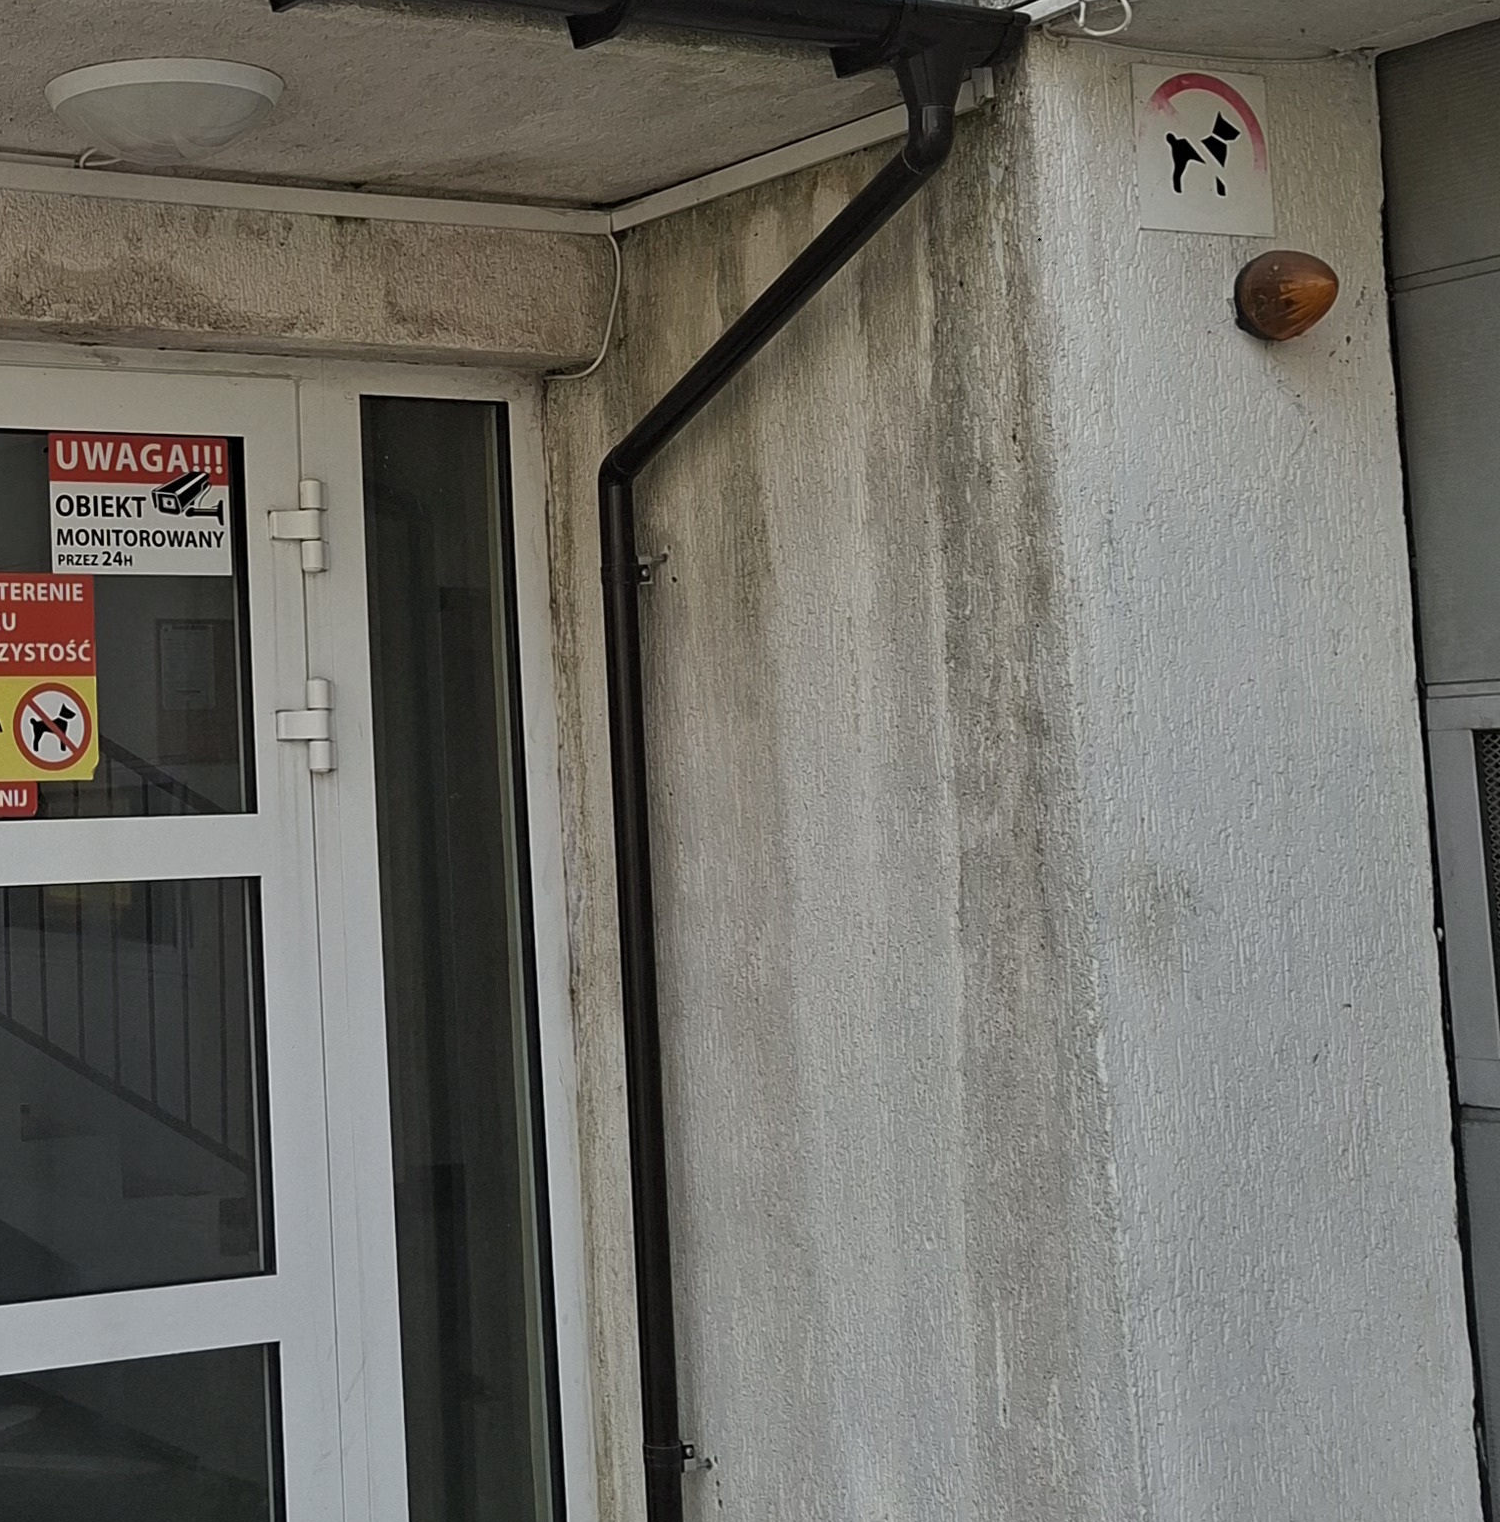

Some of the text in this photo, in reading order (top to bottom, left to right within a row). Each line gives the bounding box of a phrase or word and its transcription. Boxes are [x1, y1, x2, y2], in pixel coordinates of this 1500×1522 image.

[55, 439, 223, 475] UWAGA!!!
[55, 494, 147, 518] OBIEKT
[56, 528, 225, 549] MONITOROWANY
[58, 554, 99, 567] PRZEZ
